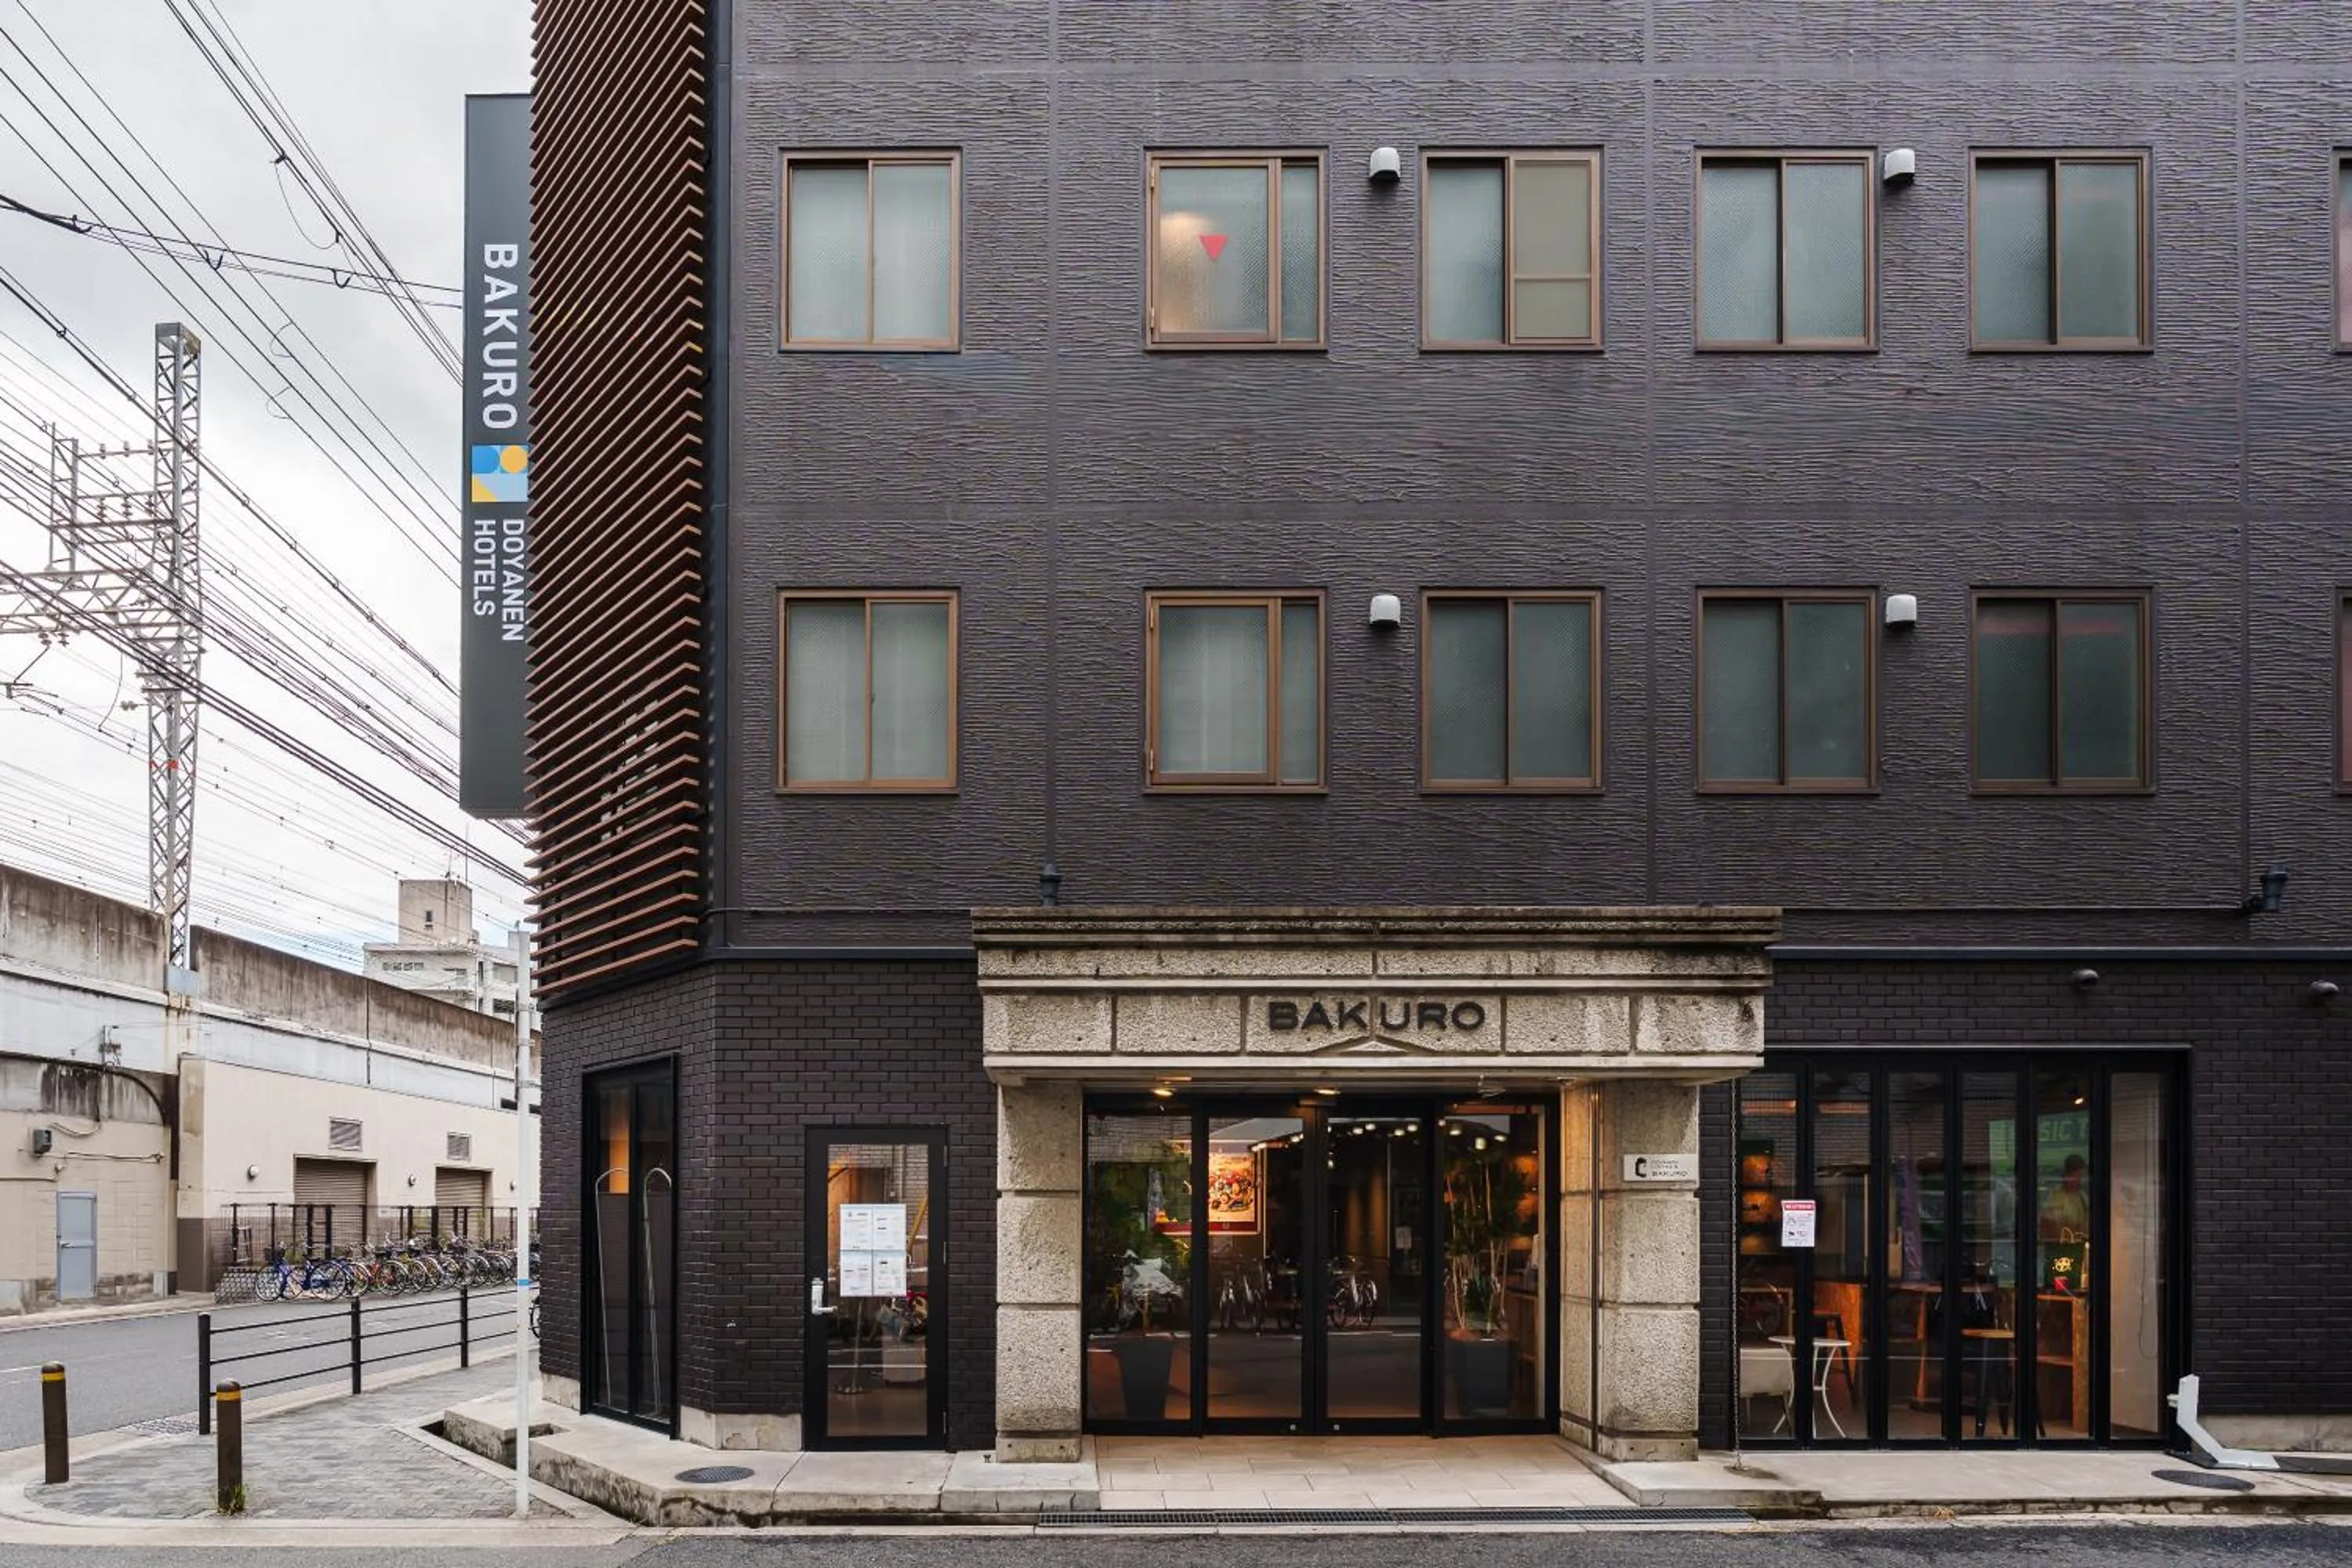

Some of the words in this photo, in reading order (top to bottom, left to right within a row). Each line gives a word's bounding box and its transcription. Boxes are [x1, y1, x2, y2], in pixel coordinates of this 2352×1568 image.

[482, 244, 519, 429] BAKURO
[474, 519, 496, 616] HOTELS
[502, 518, 524, 641] DOYANEN
[1269, 1000, 1486, 1030] BAKURO
